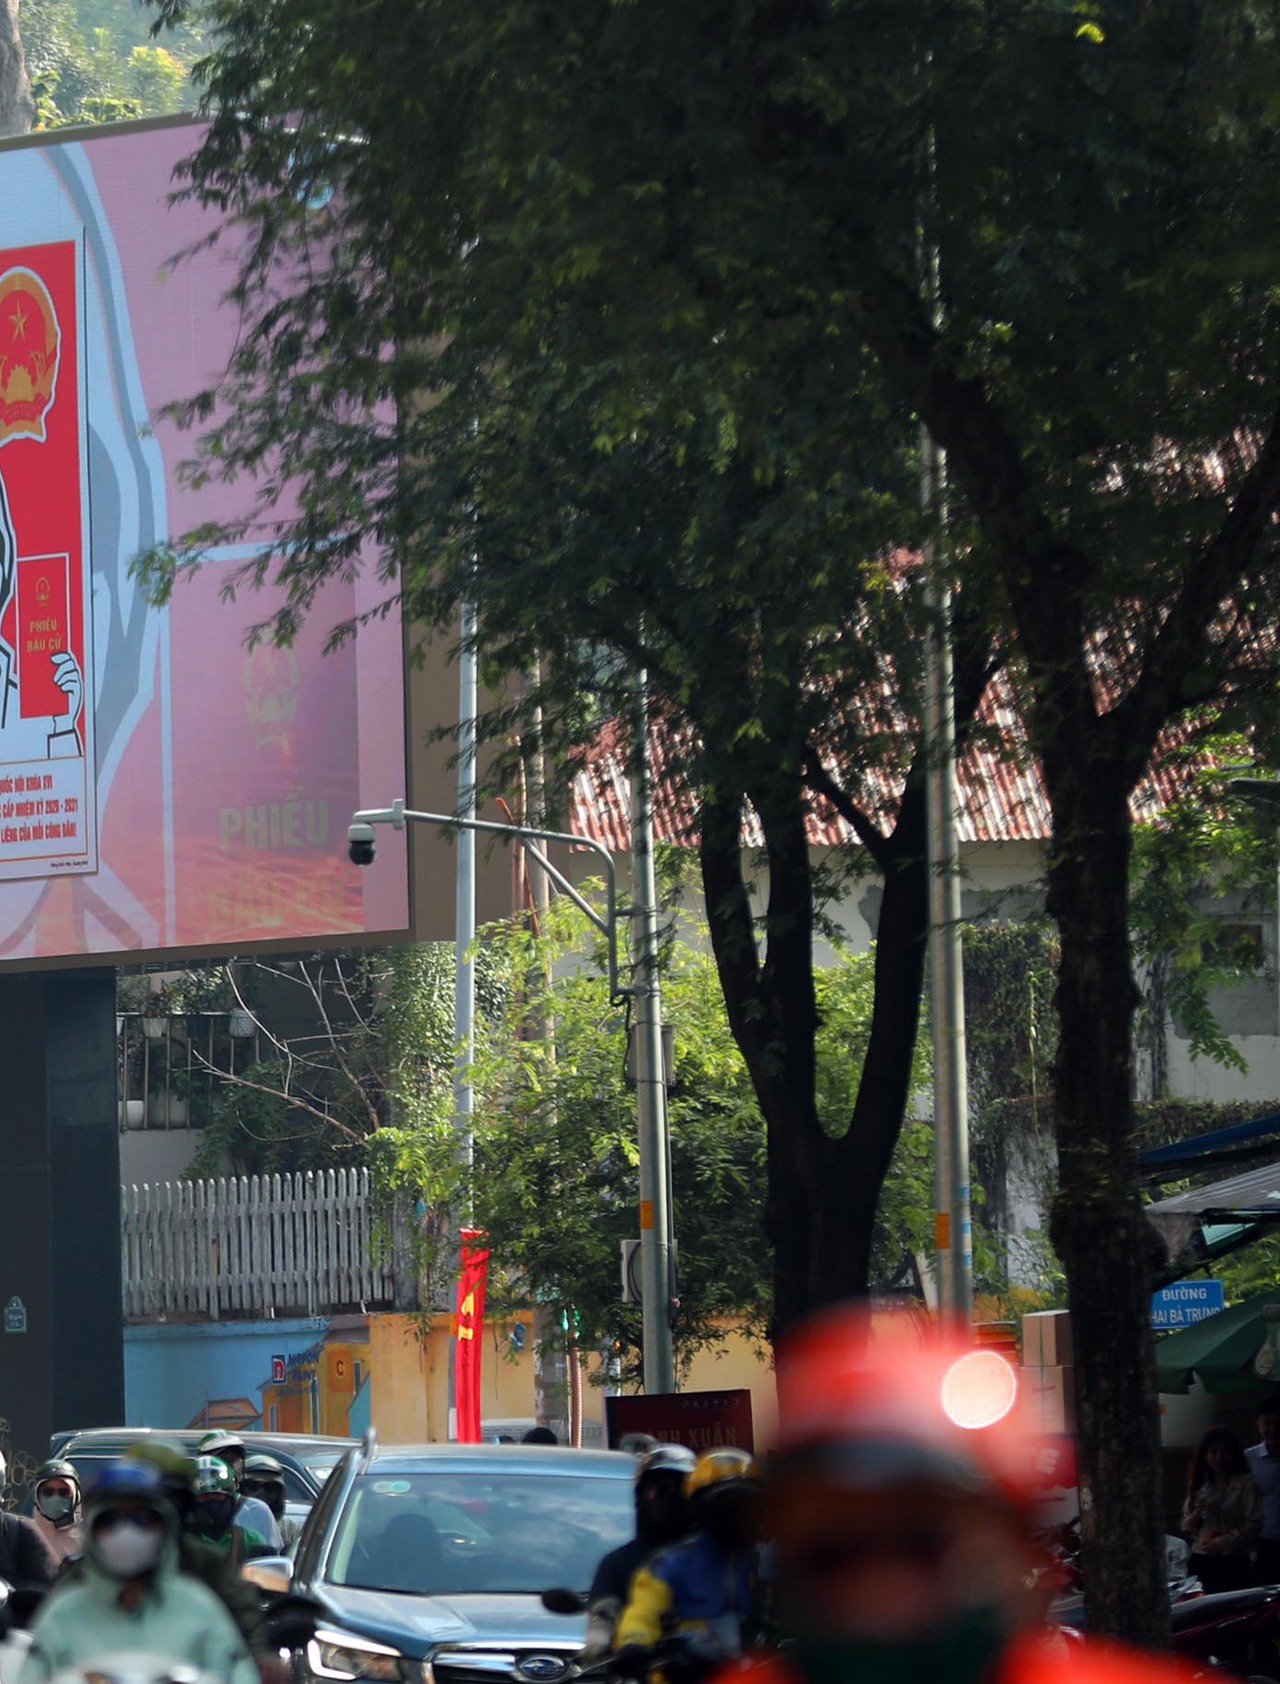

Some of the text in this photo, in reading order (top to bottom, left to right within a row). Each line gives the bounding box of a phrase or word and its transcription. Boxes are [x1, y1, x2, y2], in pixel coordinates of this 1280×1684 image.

[30, 617, 57, 633] PHIẾU
[220, 784, 330, 852] PHIẾU
[1162, 1286, 1208, 1301] ĐƯỜNG
[1170, 1305, 1184, 1324] BÀ
